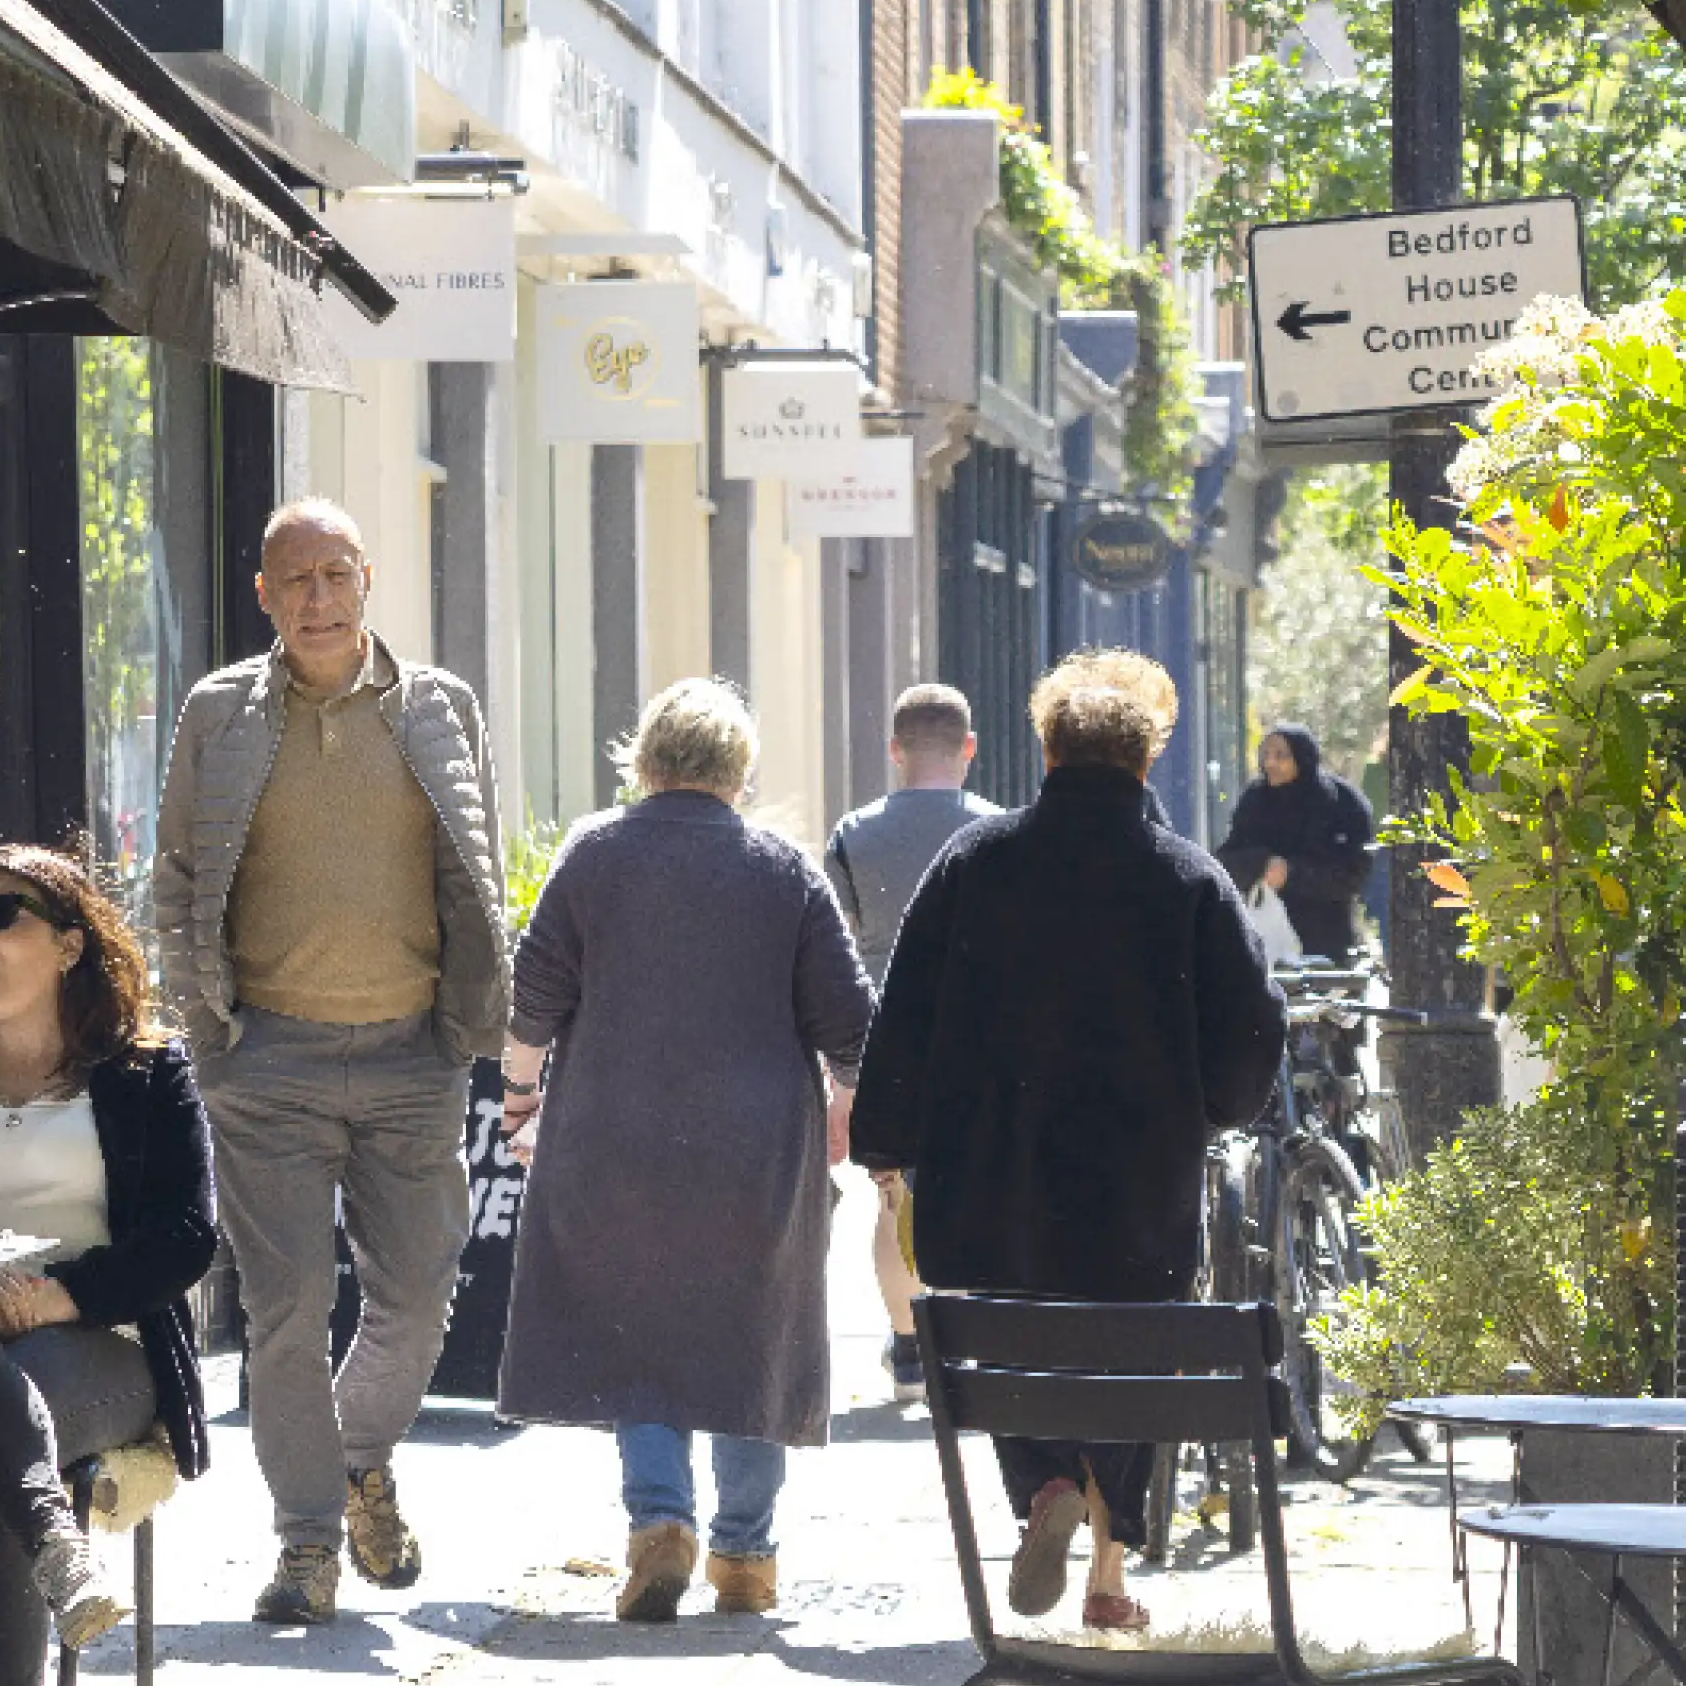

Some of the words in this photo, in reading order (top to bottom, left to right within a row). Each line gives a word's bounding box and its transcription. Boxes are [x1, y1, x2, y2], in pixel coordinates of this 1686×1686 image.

[1388, 218, 1533, 257] Bedford
[436, 271, 505, 290] FIBRES
[1406, 271, 1518, 304] House
